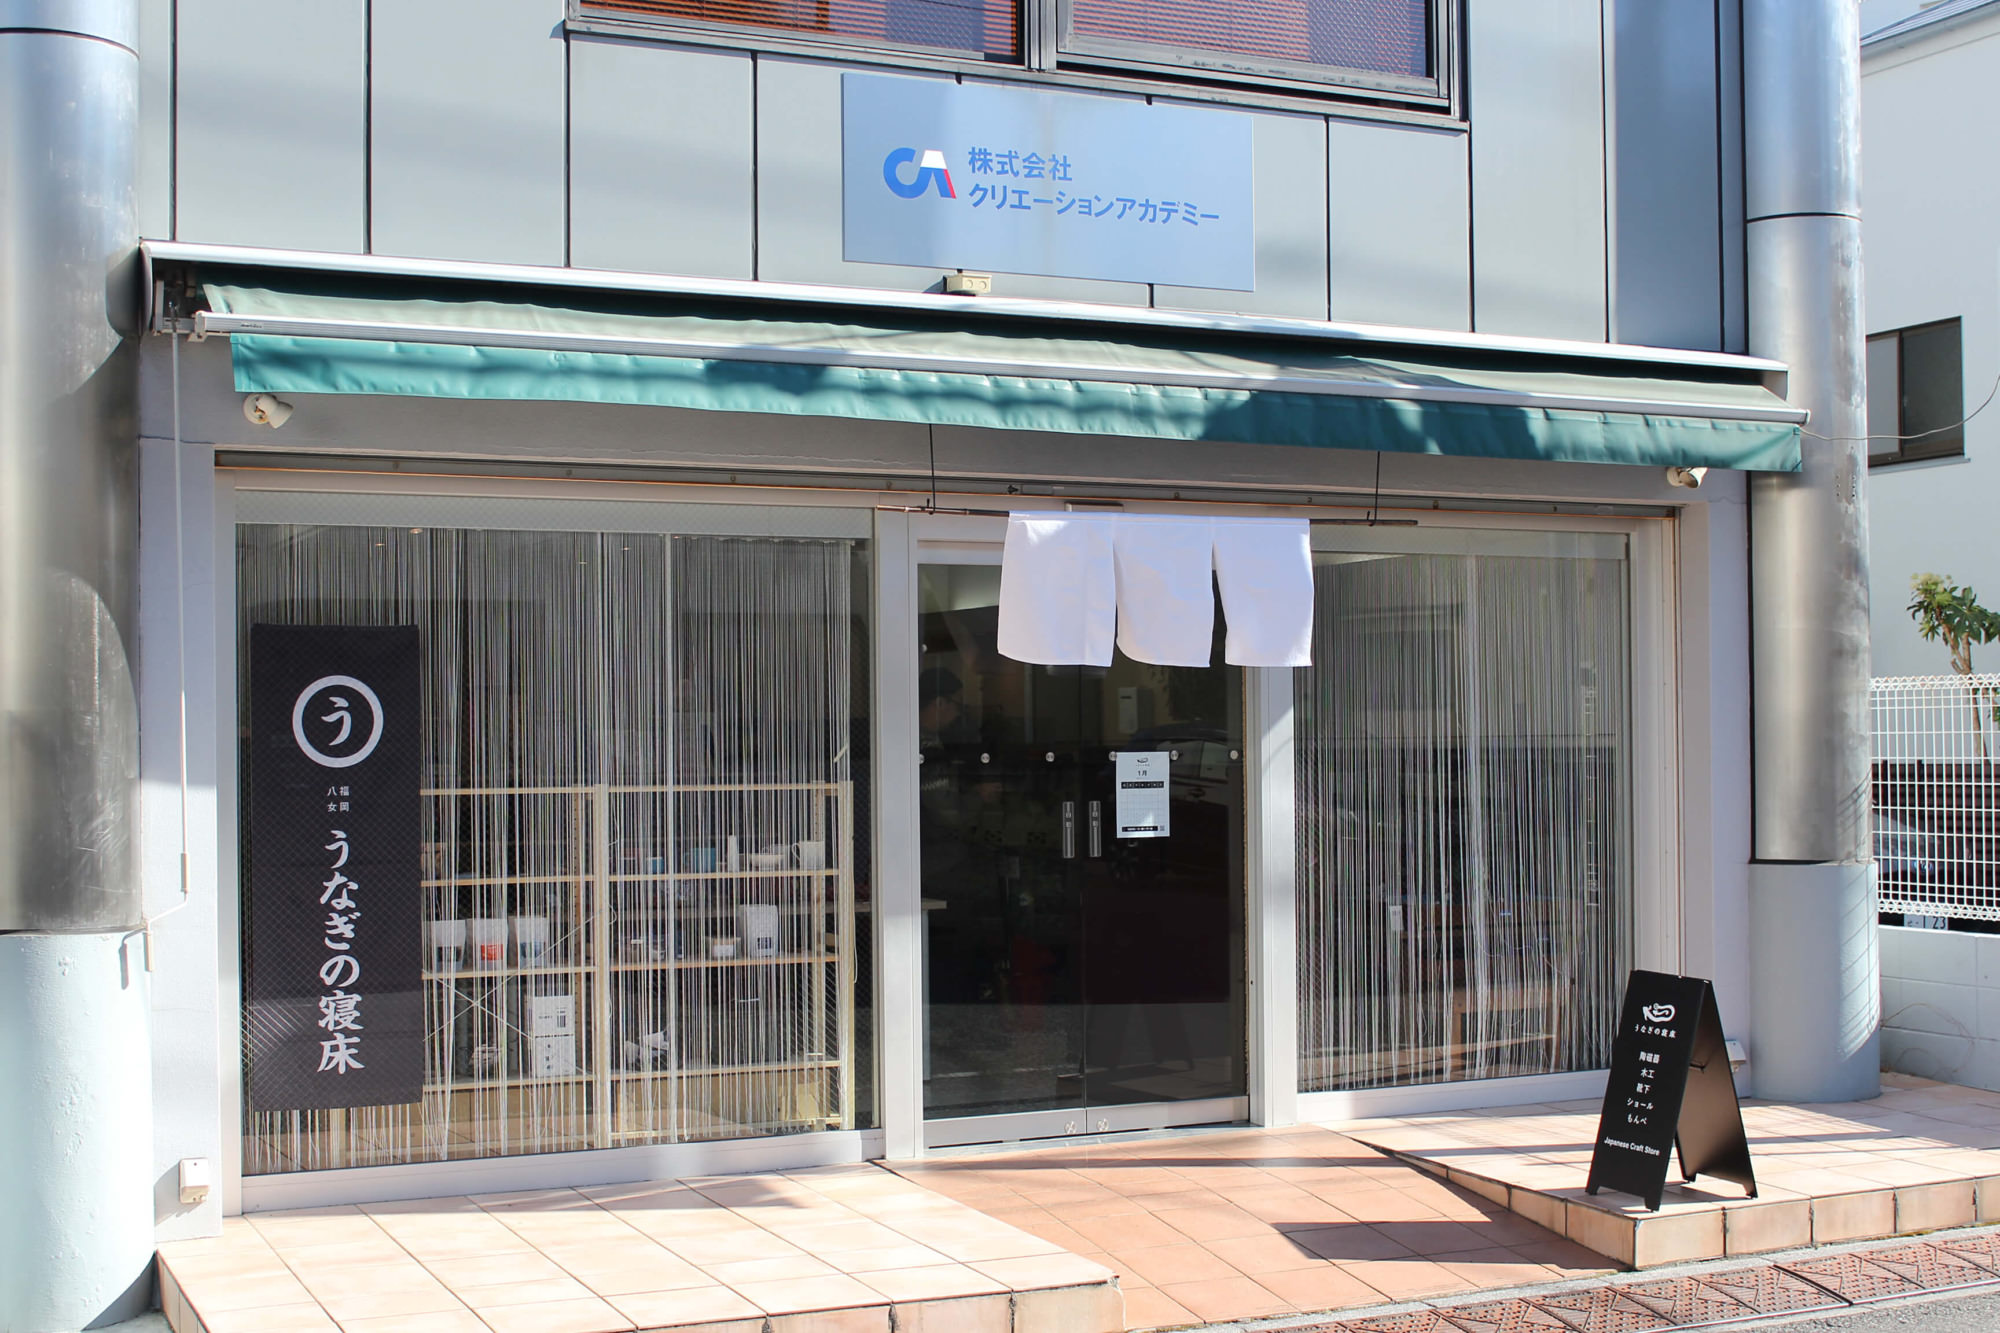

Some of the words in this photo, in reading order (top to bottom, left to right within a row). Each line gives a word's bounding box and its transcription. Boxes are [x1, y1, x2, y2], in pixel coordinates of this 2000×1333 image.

[968, 146, 1073, 181] 株式会社
[968, 183, 1220, 226] クリエーションアカデミー
[320, 696, 353, 746] う
[317, 830, 365, 1075] うなぎの寝床
[1640, 1068, 1655, 1078] 木工
[1627, 1098, 1653, 1109] ショール
[1604, 1137, 1629, 1148] Japanese
[1630, 1142, 1644, 1152] Craft
[1645, 1146, 1660, 1156] Store
